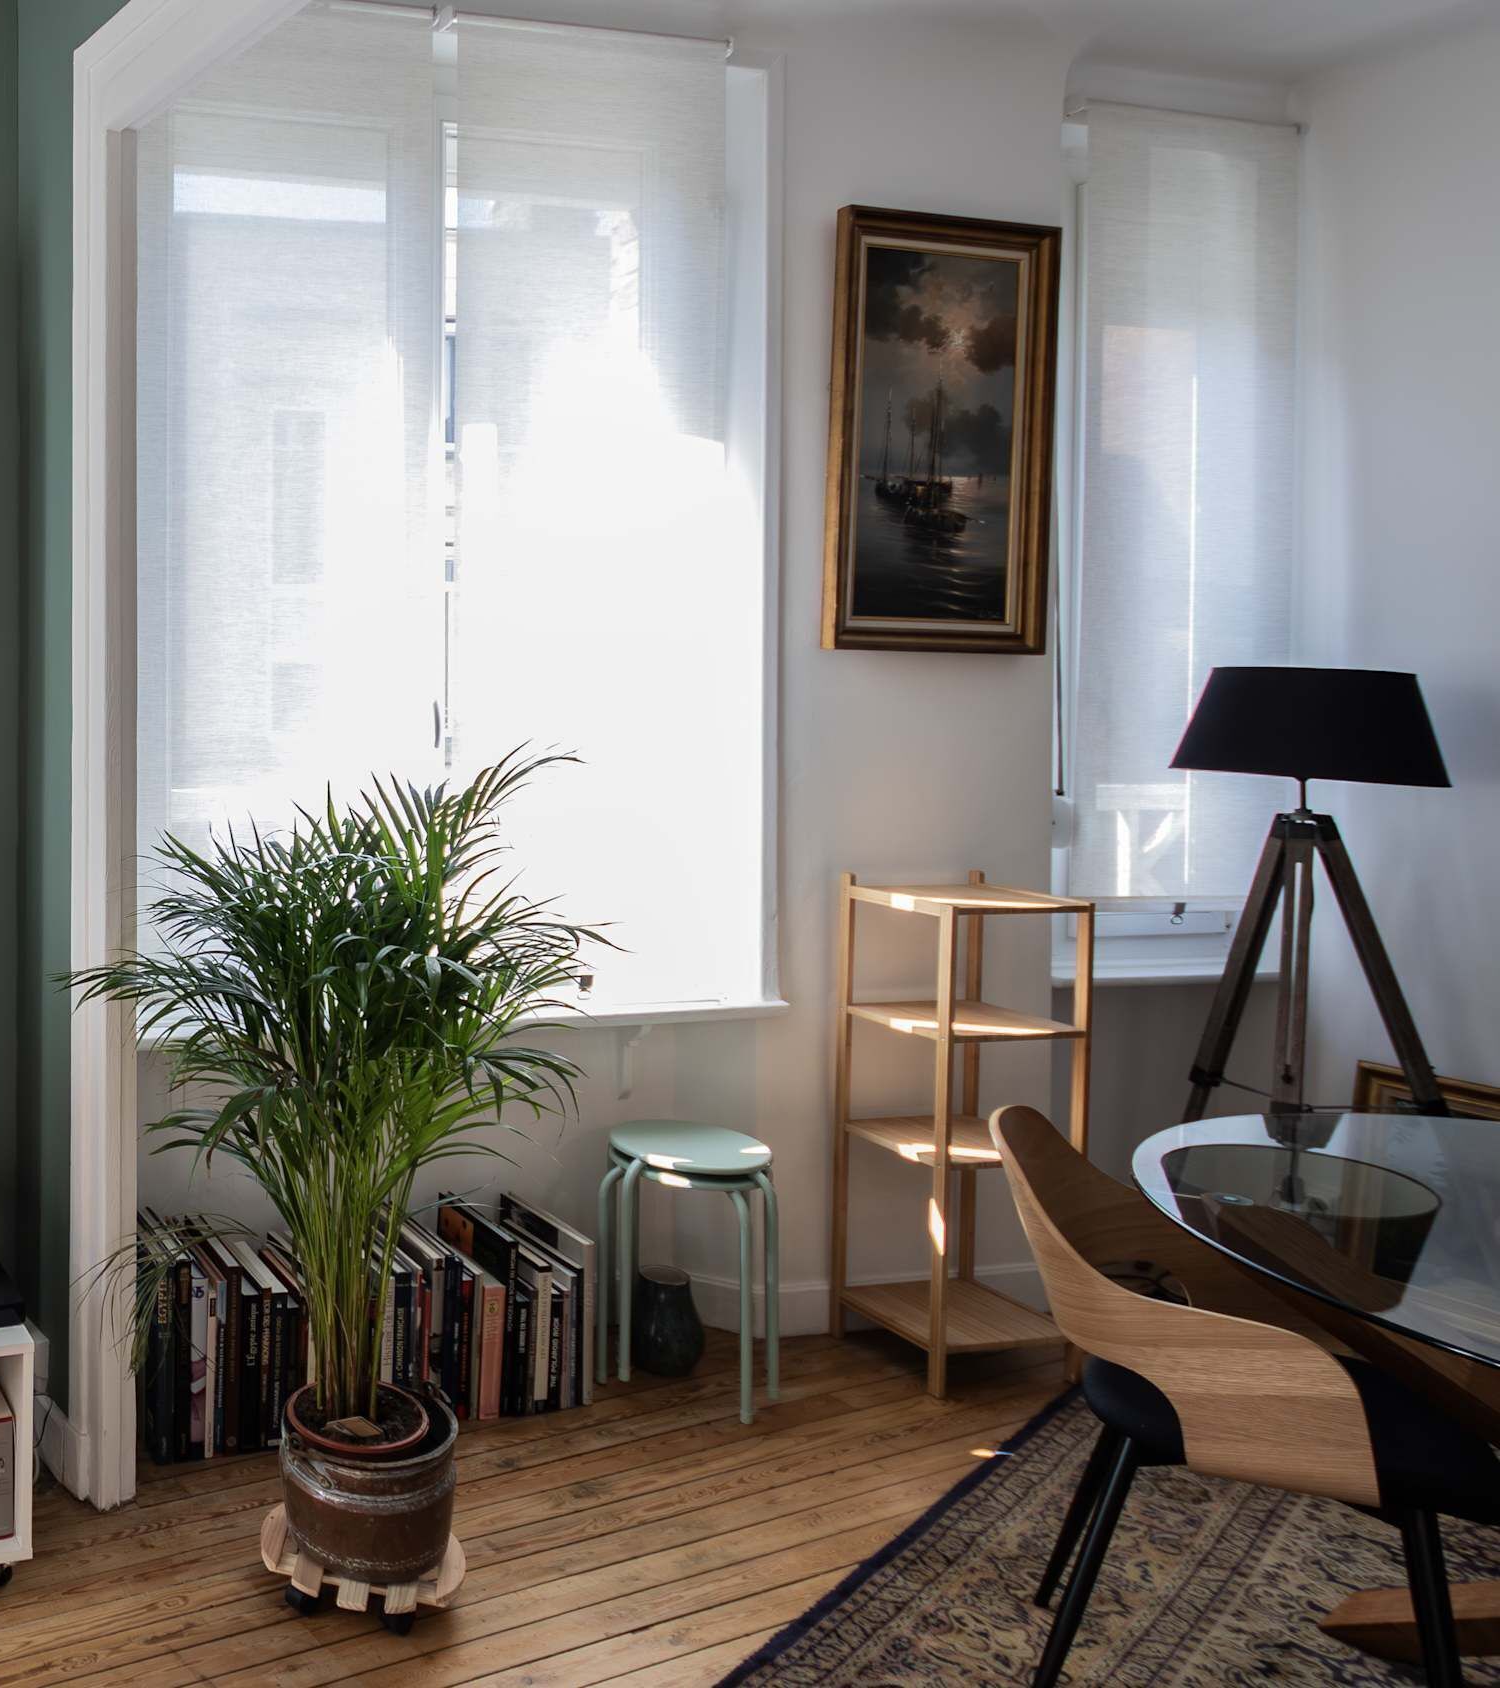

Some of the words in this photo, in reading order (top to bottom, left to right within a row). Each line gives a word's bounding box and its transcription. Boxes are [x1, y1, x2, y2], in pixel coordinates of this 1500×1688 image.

[246, 1303, 258, 1331] antique
[246, 1333, 258, 1366] L'Égypte
[396, 1341, 405, 1371] CHANSON
[550, 1375, 560, 1388] THE
